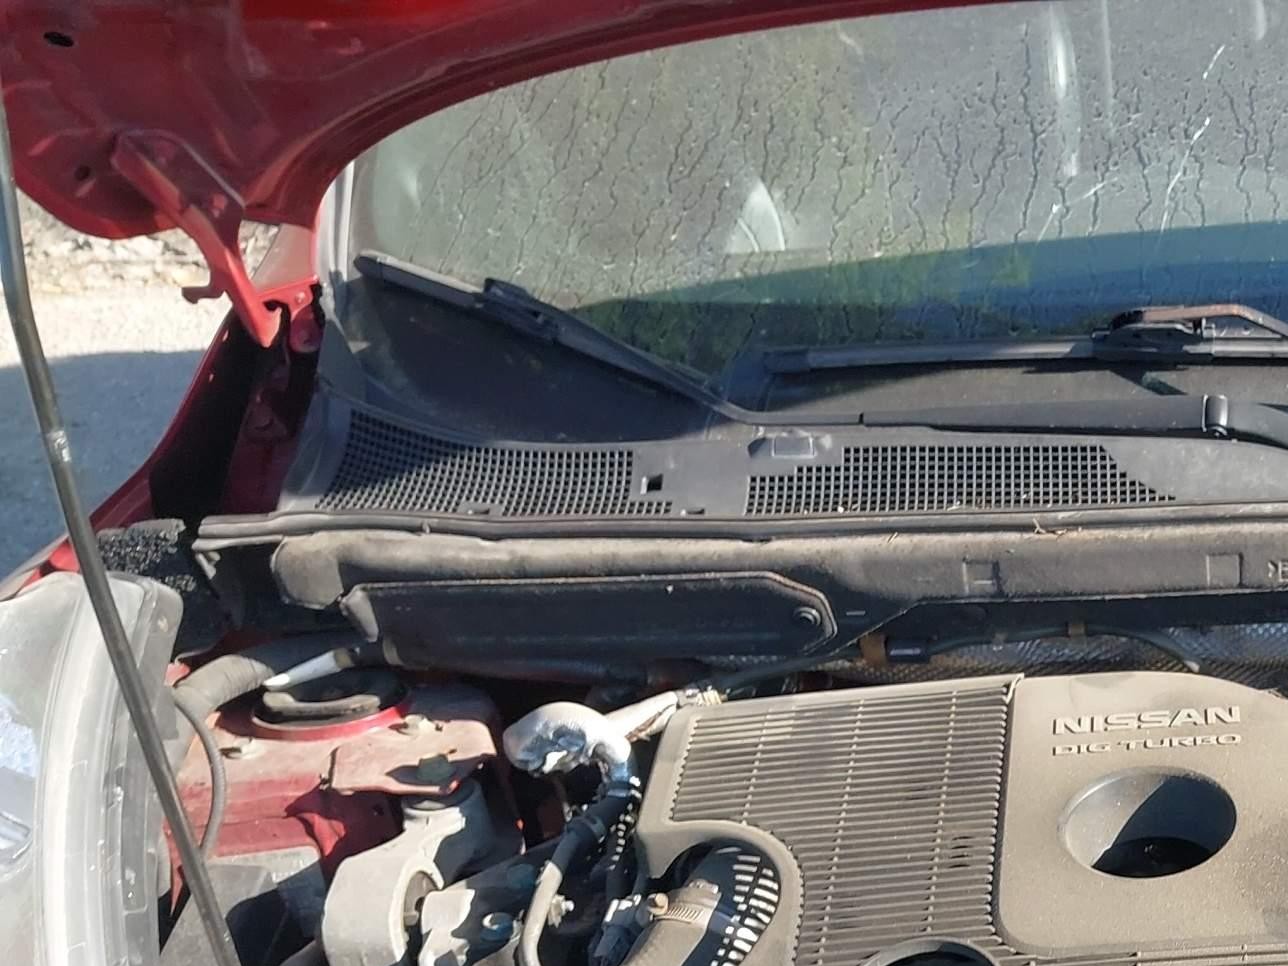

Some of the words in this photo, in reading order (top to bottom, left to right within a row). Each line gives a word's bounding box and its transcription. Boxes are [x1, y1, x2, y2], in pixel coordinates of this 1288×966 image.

[1052, 706, 1241, 735] NISSAN
[1052, 742, 1110, 757] DIG
[1117, 733, 1242, 751] TURBO
